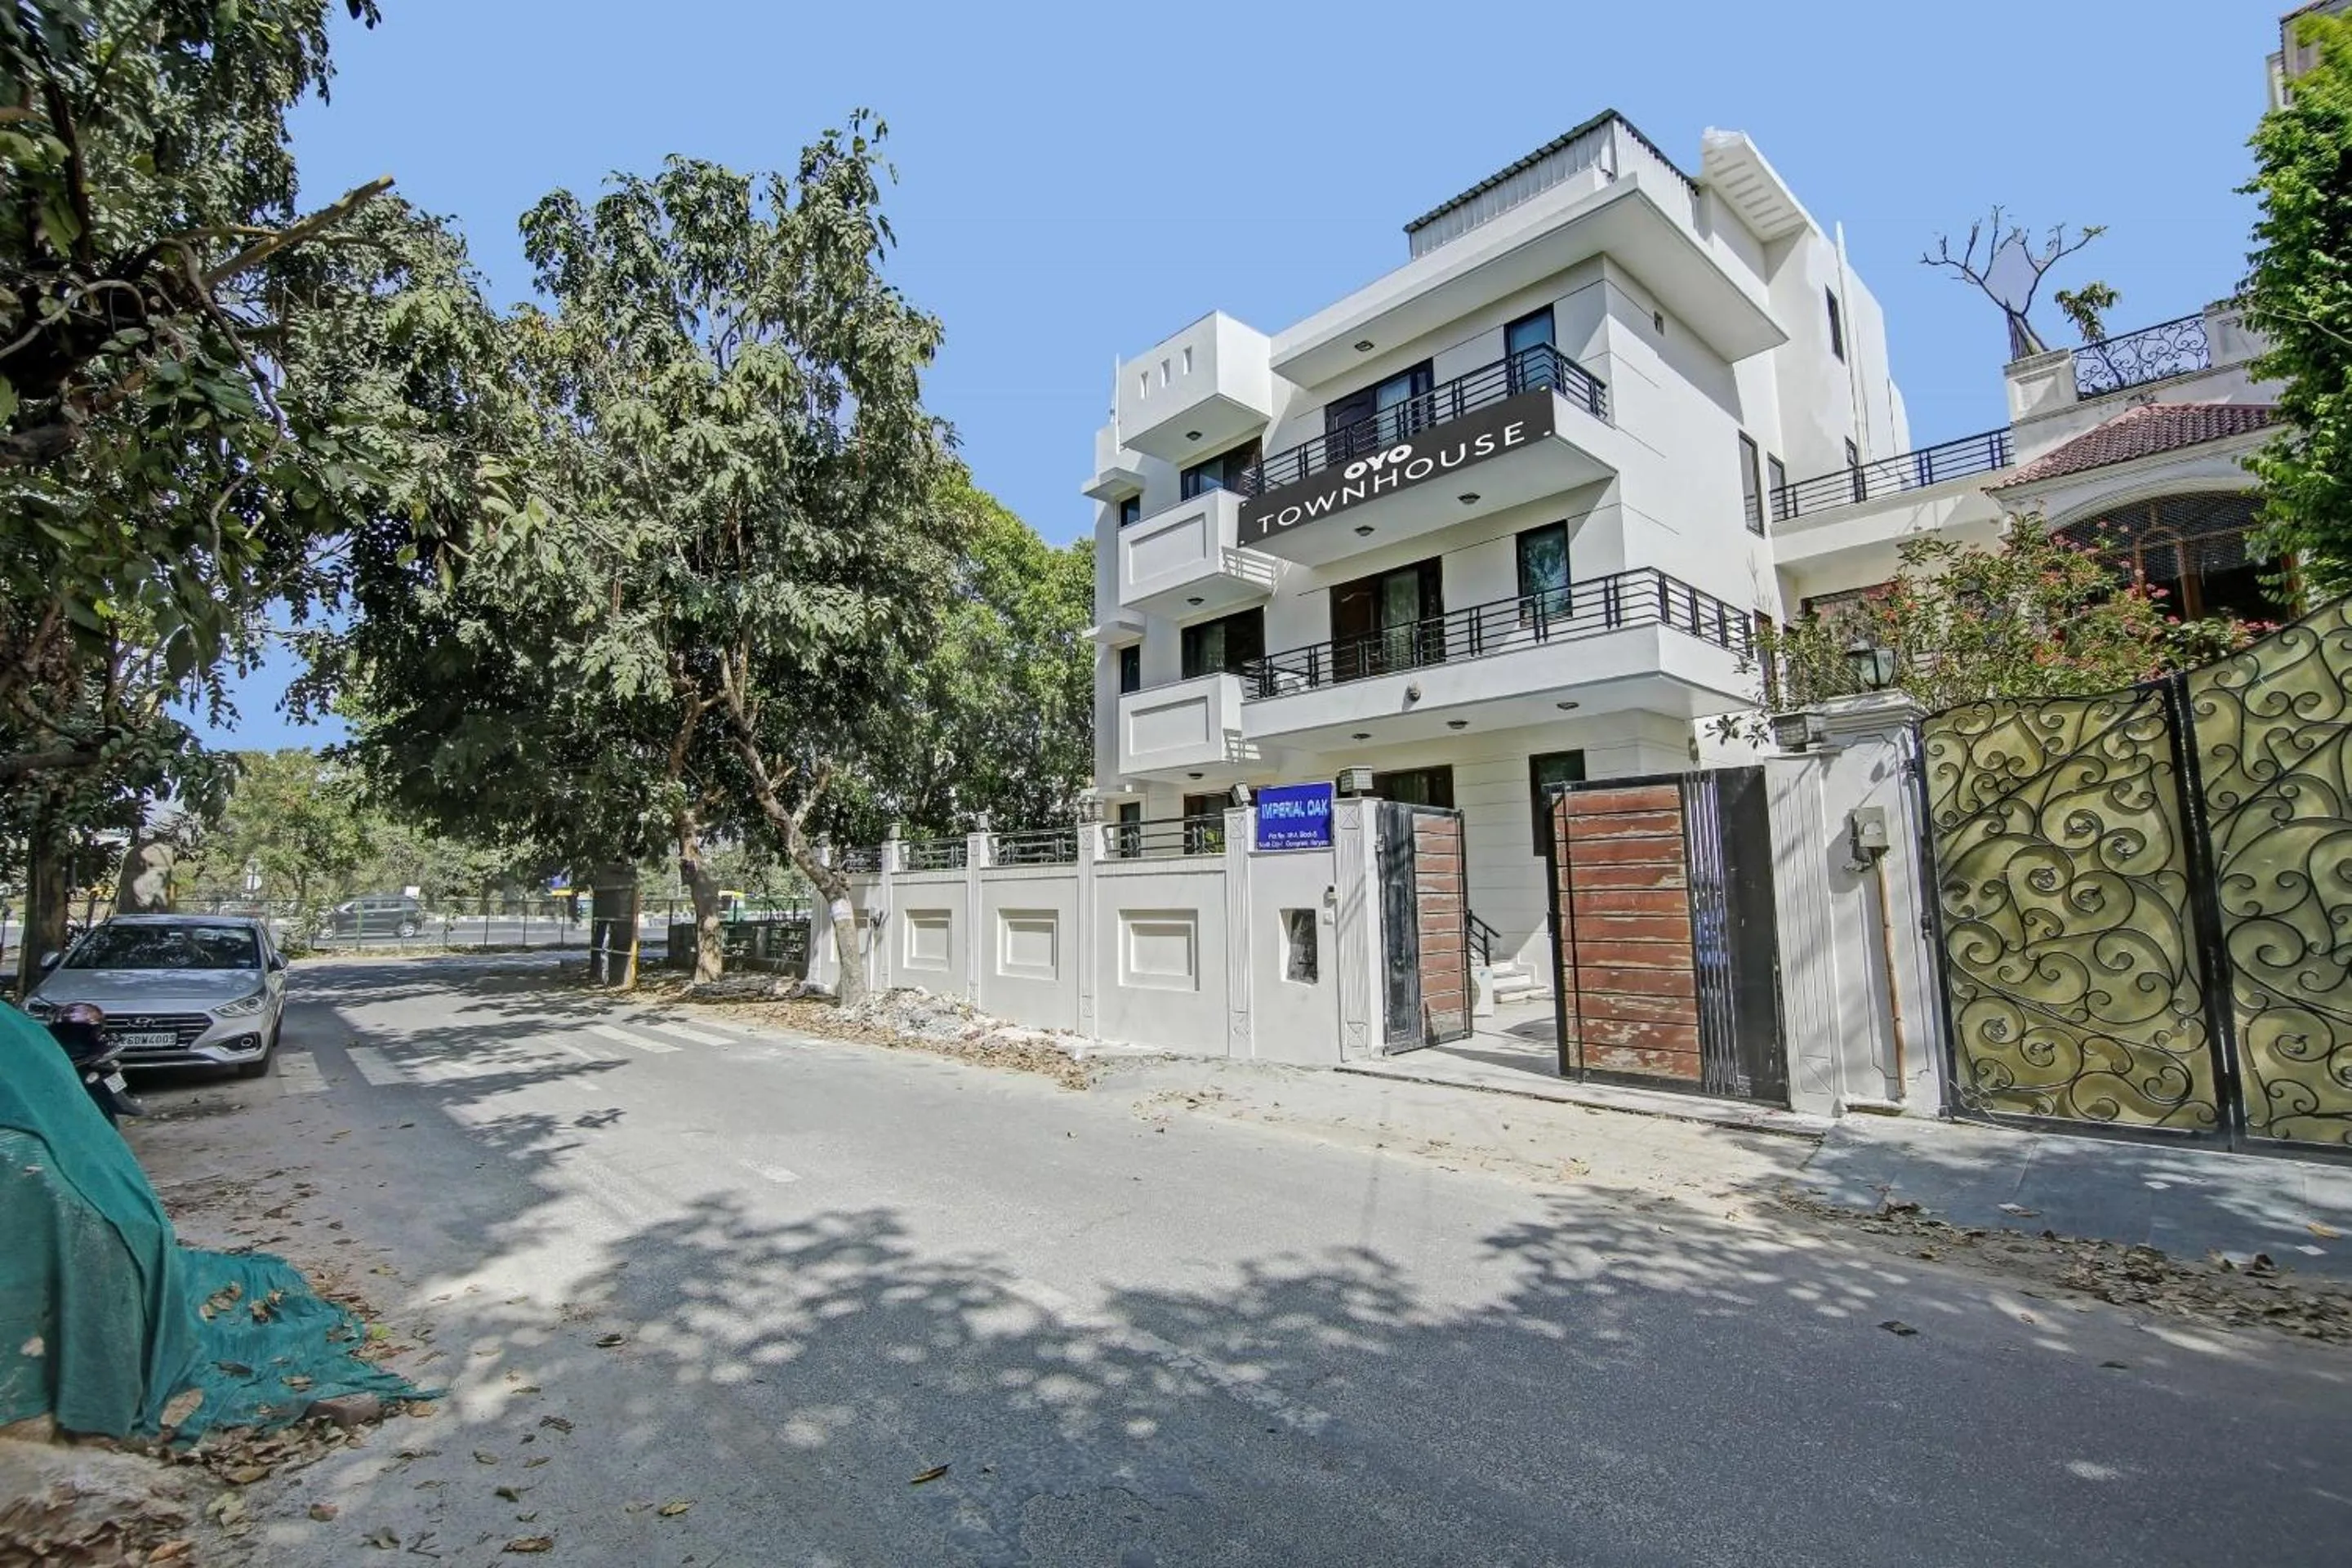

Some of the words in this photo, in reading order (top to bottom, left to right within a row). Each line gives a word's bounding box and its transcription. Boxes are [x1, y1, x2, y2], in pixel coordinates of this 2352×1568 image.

[1257, 421, 1525, 533] TOWNHOUSE
[1343, 443, 1413, 480] OYO
[1261, 801, 1305, 819] IMPERIAL
[1307, 799, 1328, 817] OAK
